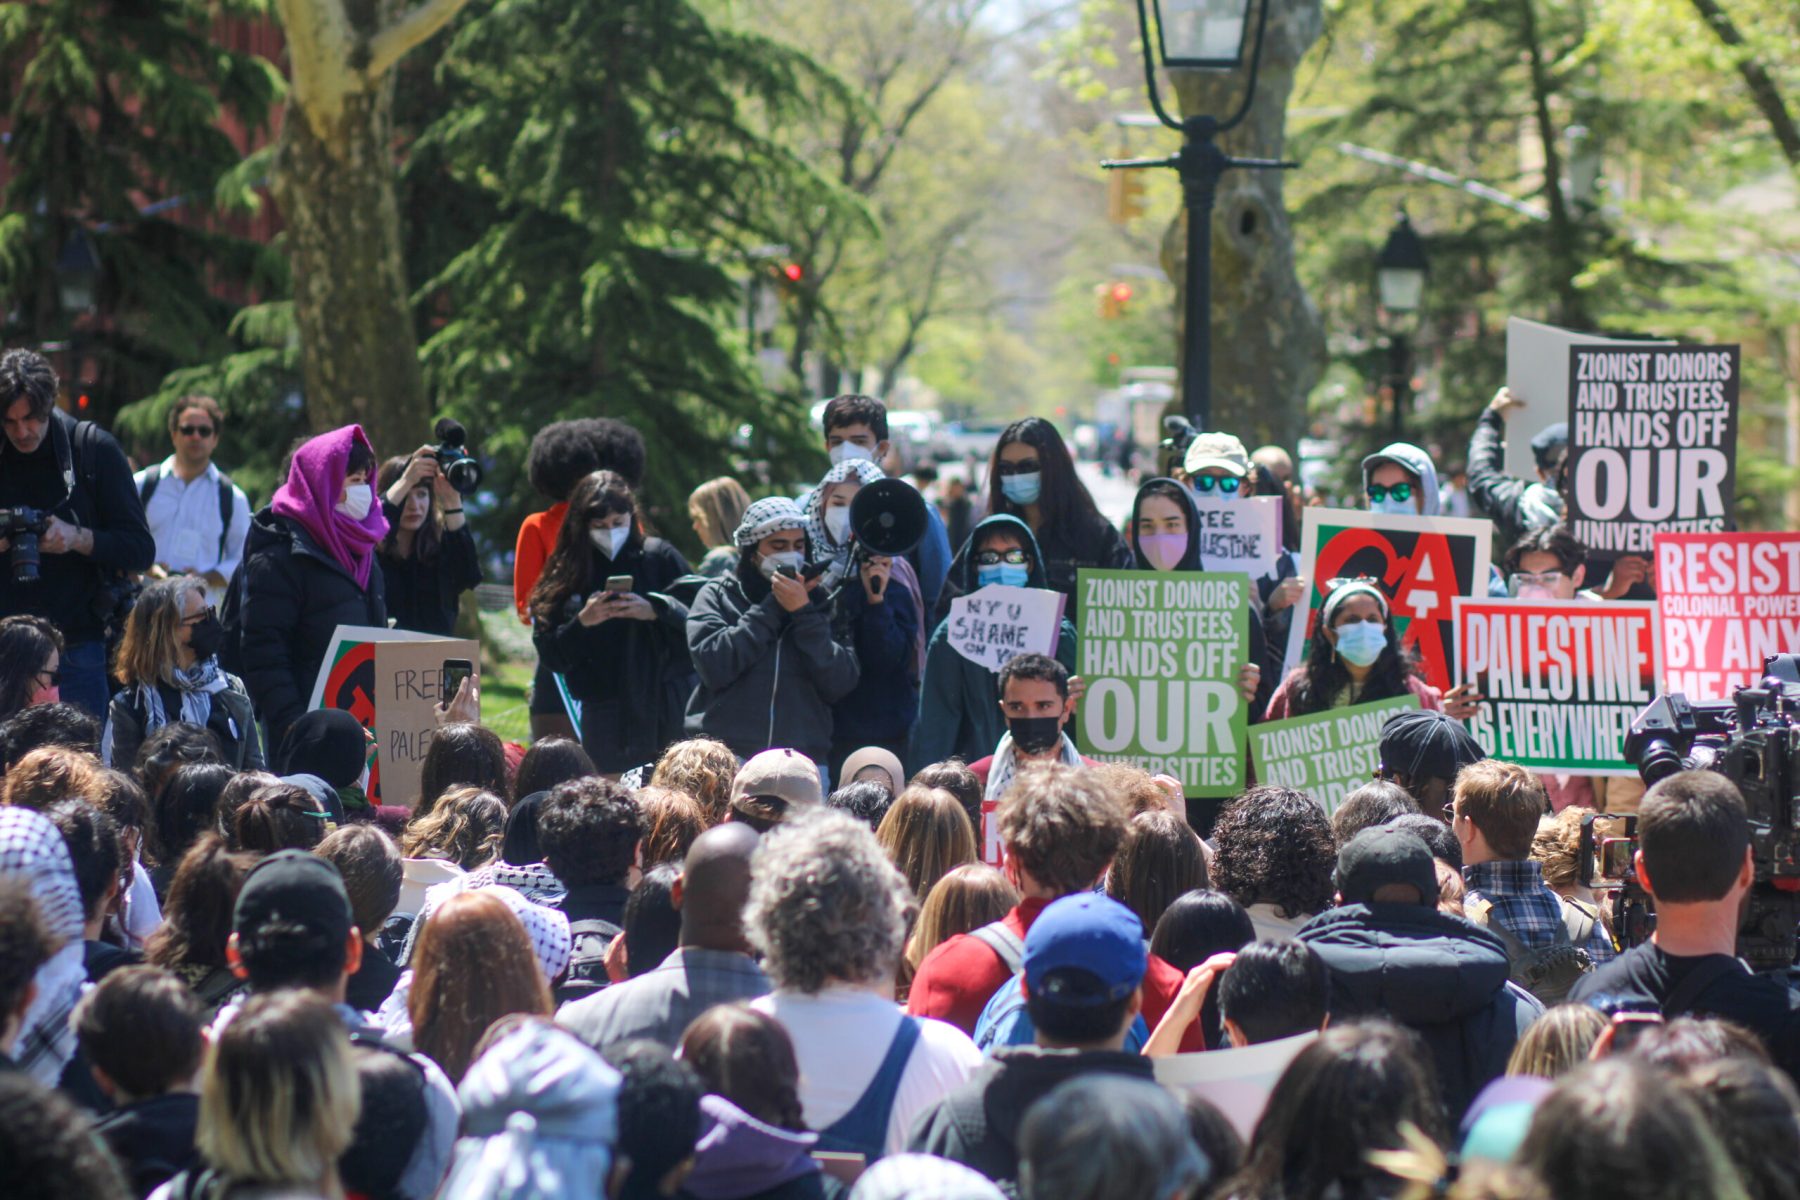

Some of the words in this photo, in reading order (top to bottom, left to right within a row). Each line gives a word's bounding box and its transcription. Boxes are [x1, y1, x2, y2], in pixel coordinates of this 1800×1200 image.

[1577, 353, 1650, 381] ZIONIST
[1655, 352, 1732, 381] DONORS
[1577, 382, 1618, 410] AND
[1575, 411, 1671, 448] HANDS
[1676, 411, 1729, 447] OFF
[1575, 447, 1728, 521] OUR
[1659, 542, 1800, 594] RESIST
[1086, 579, 1158, 608] ZIONIST
[1163, 580, 1240, 609] DONORS
[1663, 594, 1740, 617] COLONIAL
[1743, 594, 1800, 618] POWE
[952, 616, 1028, 648] SHAME
[1085, 609, 1126, 637] AND
[963, 642, 986, 656] ON
[1084, 639, 1178, 677] HANDS
[1186, 641, 1239, 678] OFF
[1466, 612, 1650, 703] PALESTINE
[1664, 618, 1712, 669] BY
[1721, 618, 1800, 670] ANY
[395, 670, 443, 700] FRE
[1084, 677, 1238, 755] OUR
[1258, 721, 1332, 761] ZIONIST
[1266, 757, 1308, 786] AND
